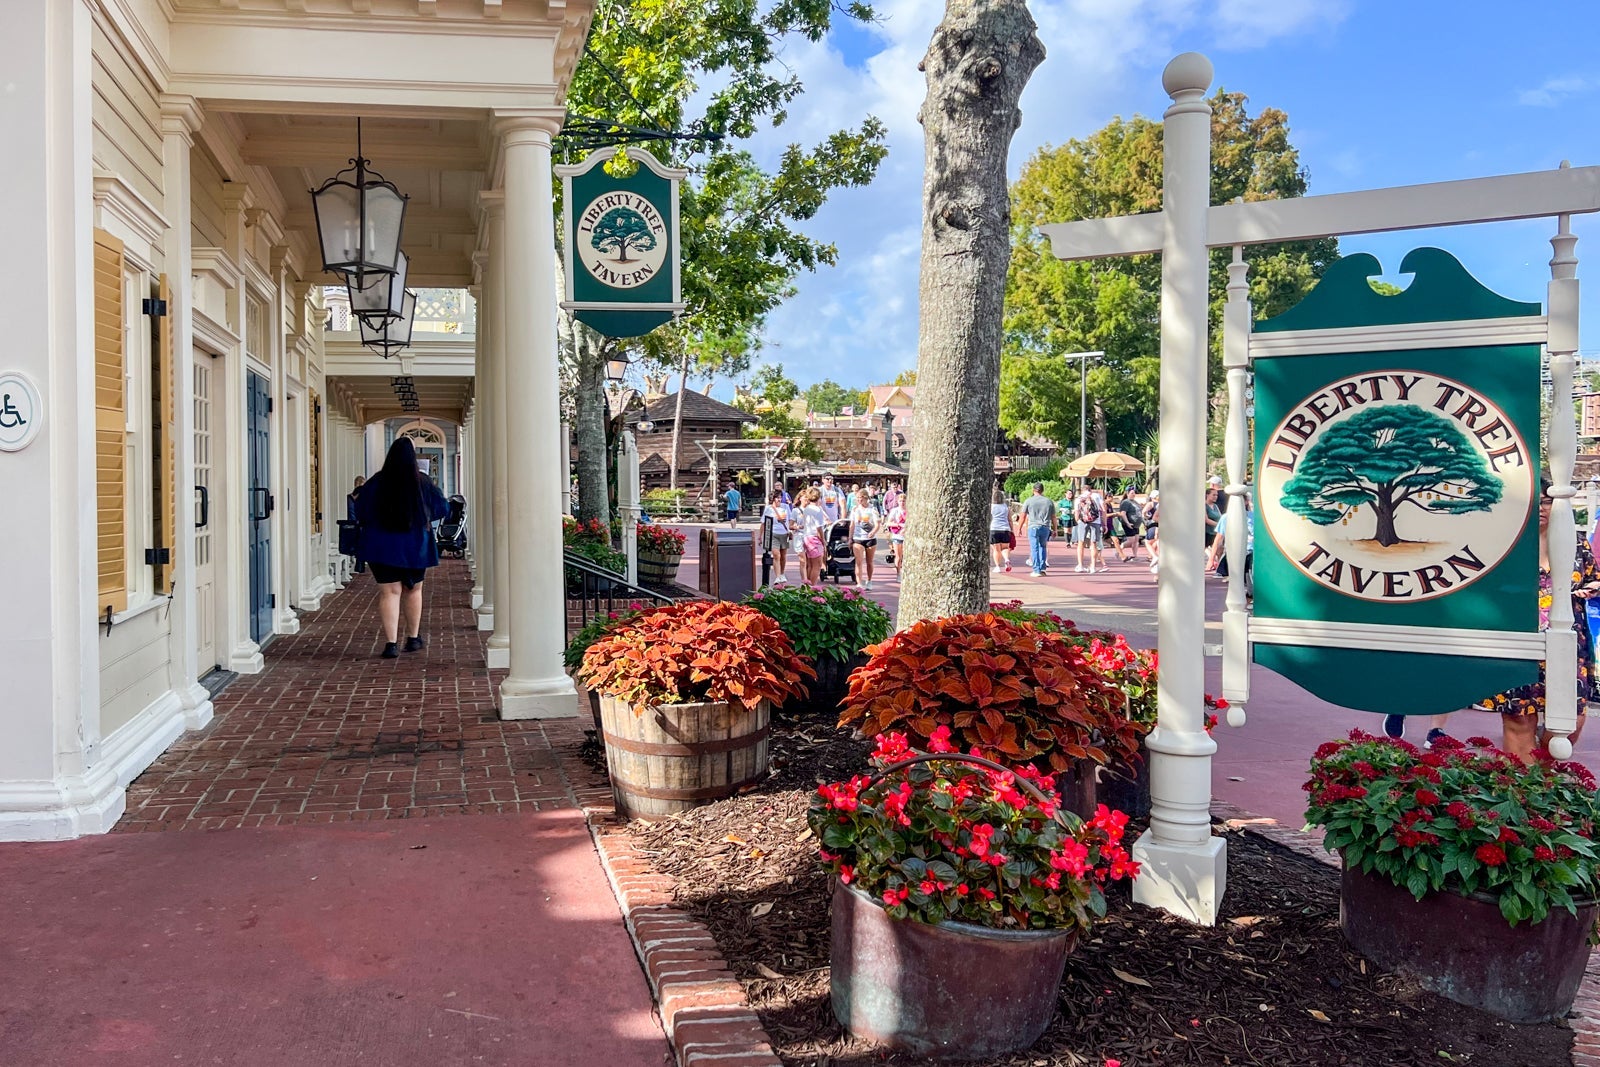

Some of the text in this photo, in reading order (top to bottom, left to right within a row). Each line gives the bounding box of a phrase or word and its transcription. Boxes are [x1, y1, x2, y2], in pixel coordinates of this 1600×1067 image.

[581, 194, 664, 235] LIBERTY TREE
[592, 261, 654, 286] TAVERN
[1267, 375, 1523, 473] LIBERTY TREE
[1299, 541, 1486, 598] TAVERN
